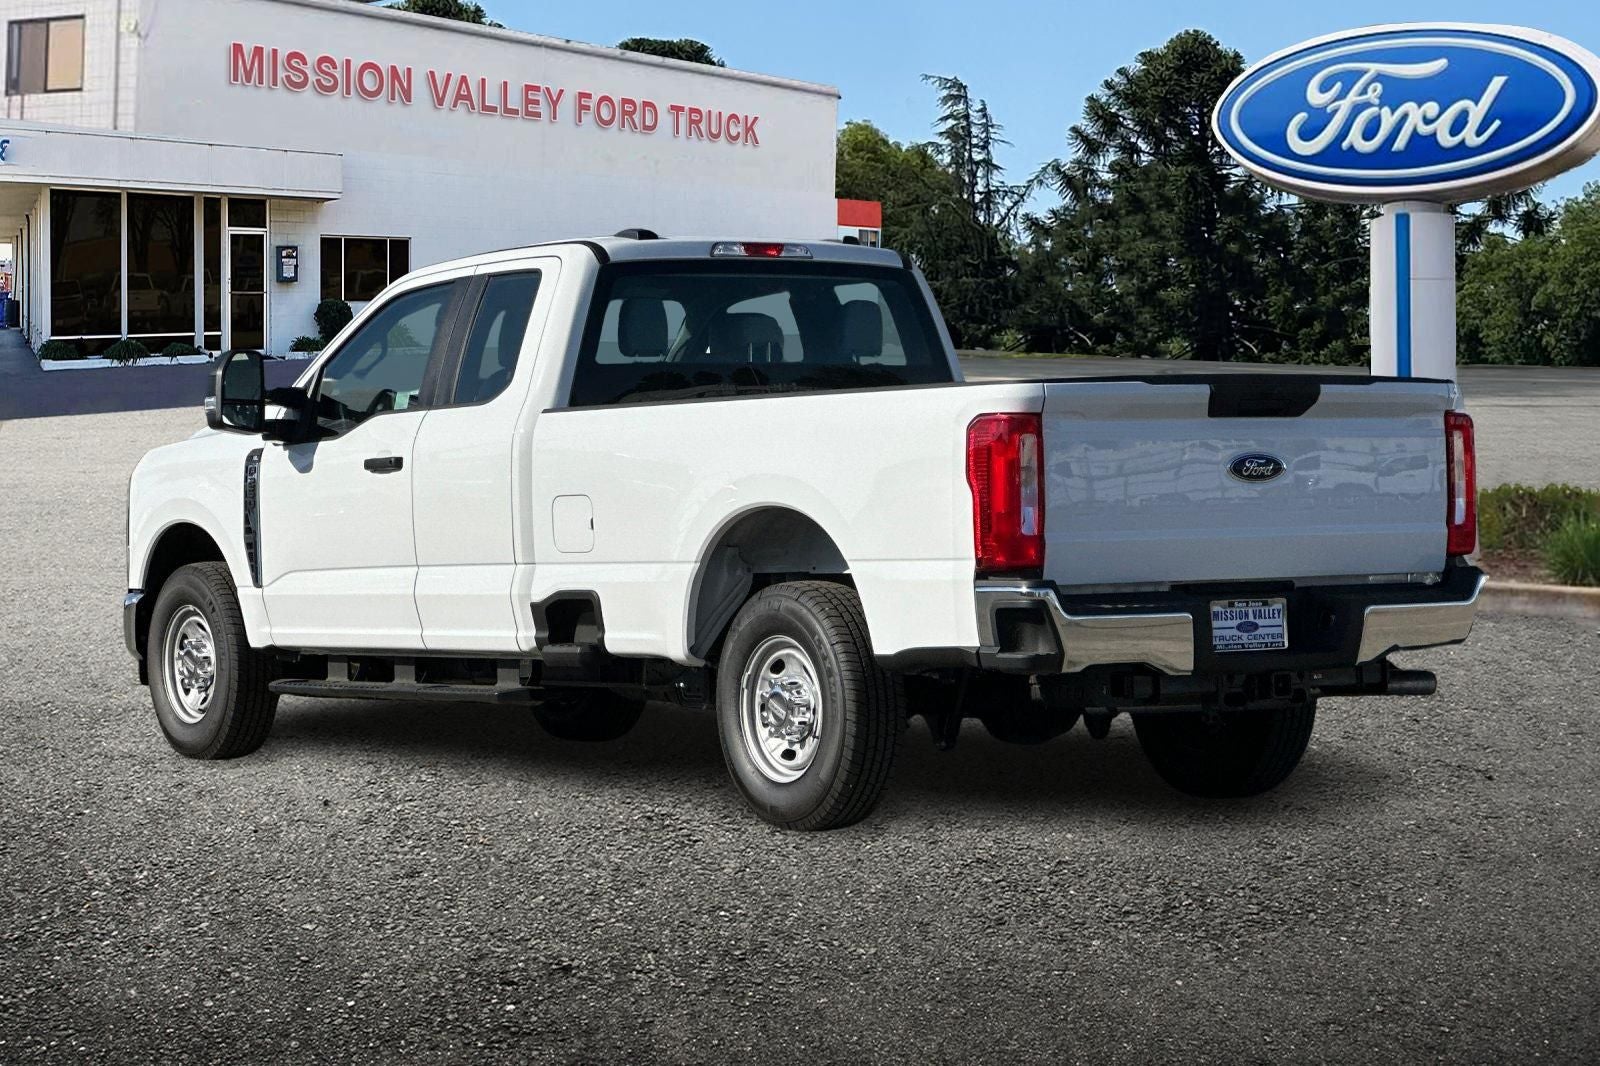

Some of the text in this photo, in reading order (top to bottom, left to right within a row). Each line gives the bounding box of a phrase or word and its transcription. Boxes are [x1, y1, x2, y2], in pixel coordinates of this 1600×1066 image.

[230, 41, 761, 147] MISSION VALLEY FORD TRUCK
[1286, 57, 1509, 157] Ford
[1242, 458, 1274, 476] Ford
[1212, 608, 1282, 621] MISSION VALLEY
[1214, 633, 1283, 642] TRUCK CENTER
